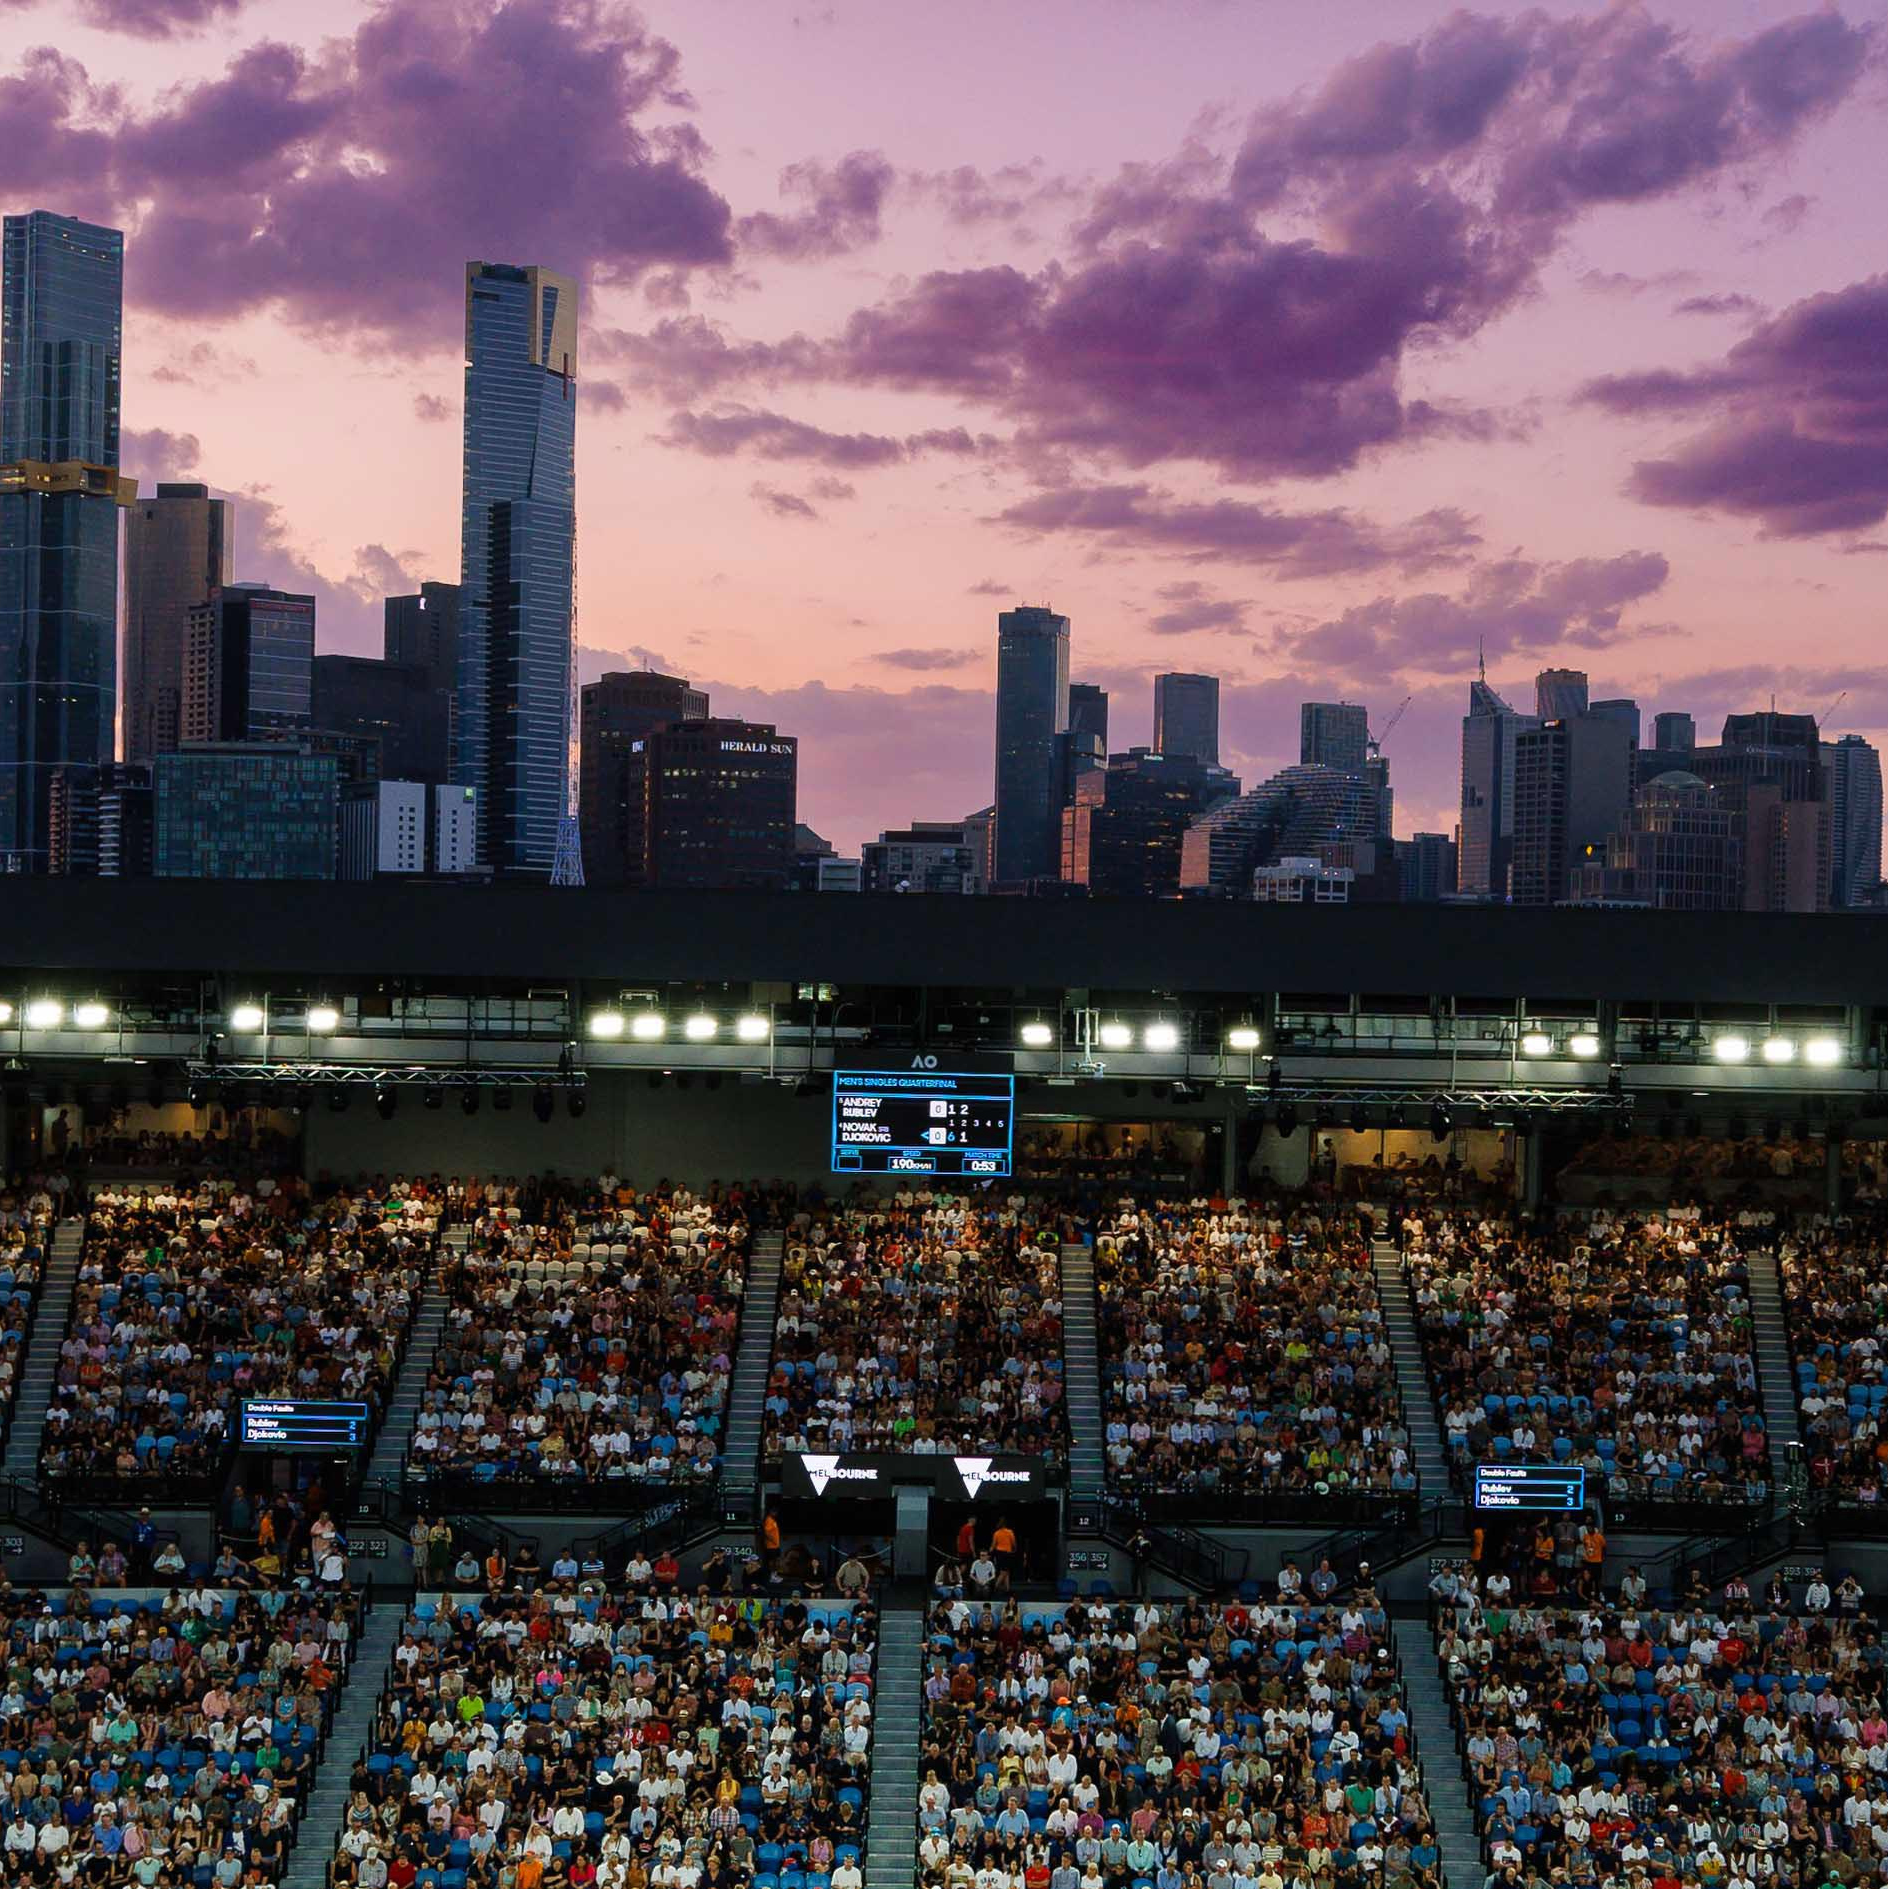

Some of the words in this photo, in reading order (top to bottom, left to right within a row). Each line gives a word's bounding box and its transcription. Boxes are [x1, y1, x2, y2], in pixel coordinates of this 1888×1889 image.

[720, 741, 767, 753] HERALD
[770, 744, 792, 754] SUN
[864, 1078, 897, 1087] SINGLES
[898, 1079, 957, 1088] QUARTERFINAL
[843, 1098, 882, 1107] ANDREY
[843, 1108, 877, 1118] RUBLEV
[948, 1105, 956, 1115] 1
[961, 1105, 969, 1115] 2
[843, 1123, 876, 1132] NOVAK
[842, 1132, 891, 1143] DJOKOVIC
[947, 1131, 955, 1141] 6
[960, 1132, 967, 1142] 1
[971, 1160, 997, 1171] 0:53
[247, 1418, 279, 1428] Rublev
[349, 1421, 356, 1430] 2
[349, 1433, 357, 1441] 3
[809, 1469, 878, 1480] MELBOURNE
[962, 1471, 1031, 1483] MELBOURNE
[1481, 1484, 1512, 1493] Rublev
[1567, 1486, 1574, 1494] 2
[1567, 1497, 1574, 1506] 3
[1079, 1517, 1089, 1525] 12
